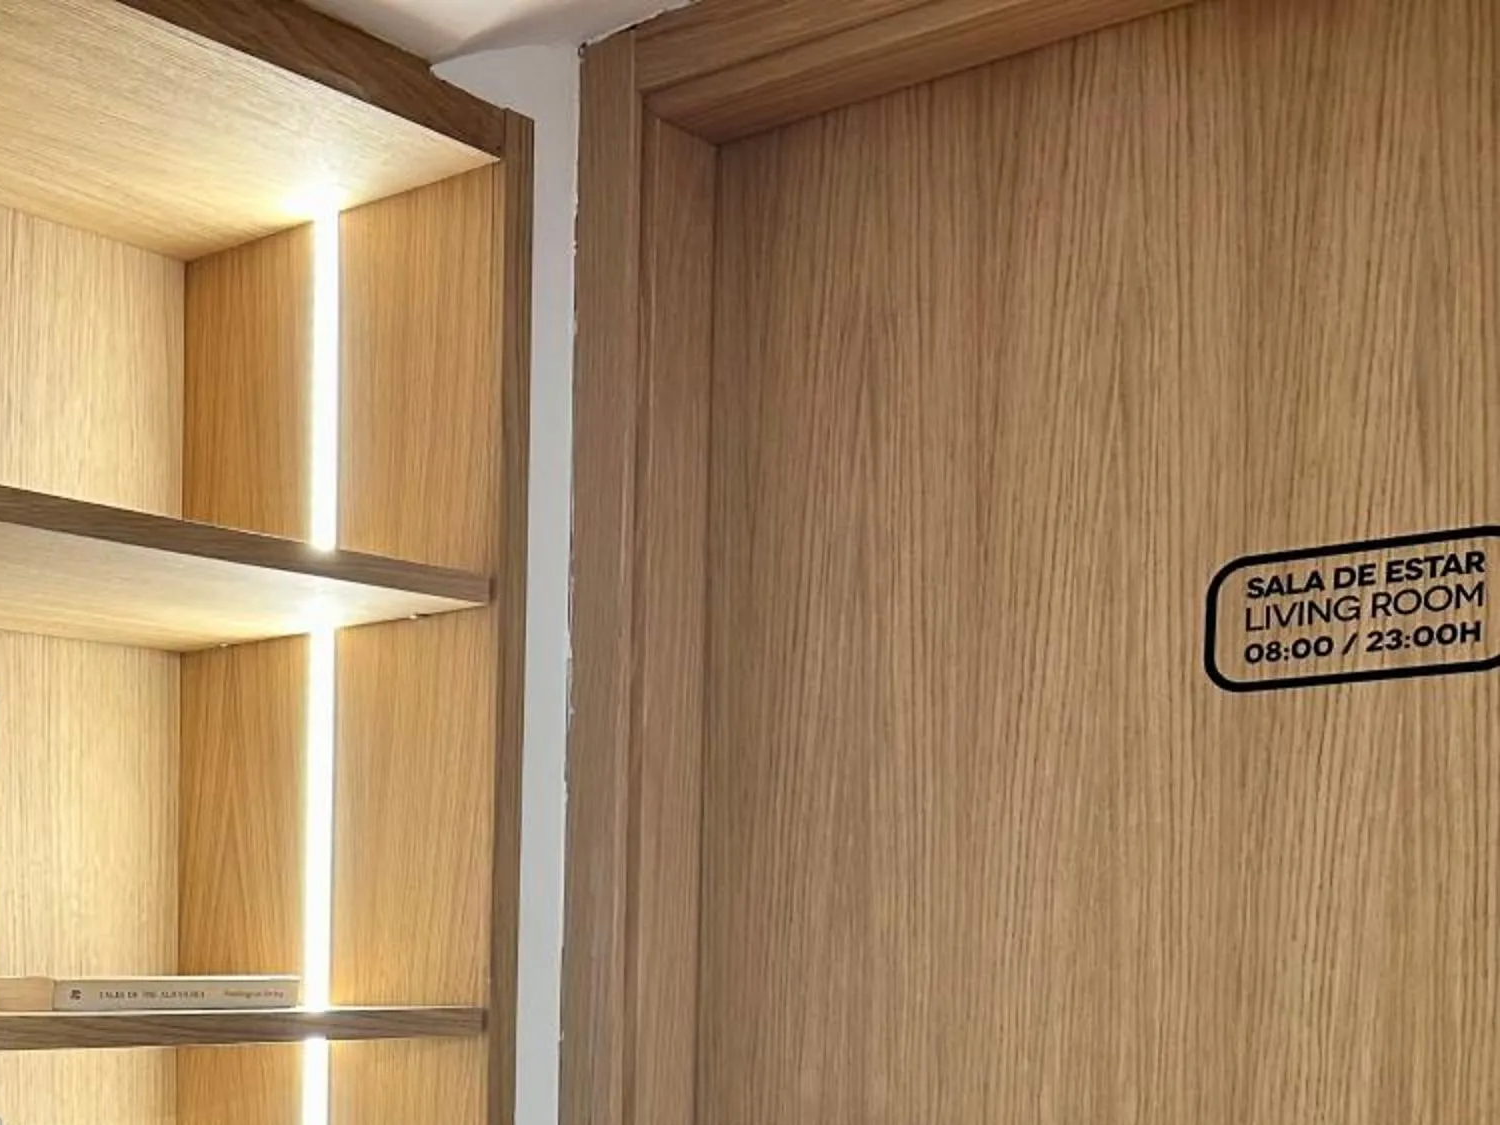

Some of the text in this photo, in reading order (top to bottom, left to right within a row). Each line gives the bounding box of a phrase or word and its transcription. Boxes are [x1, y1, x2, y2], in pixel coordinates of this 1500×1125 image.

[1246, 550, 1486, 599] SALA DE ESTAR
[1245, 581, 1485, 632] LIVING ROOM
[1244, 620, 1482, 664] 08:00 / 23:00H
